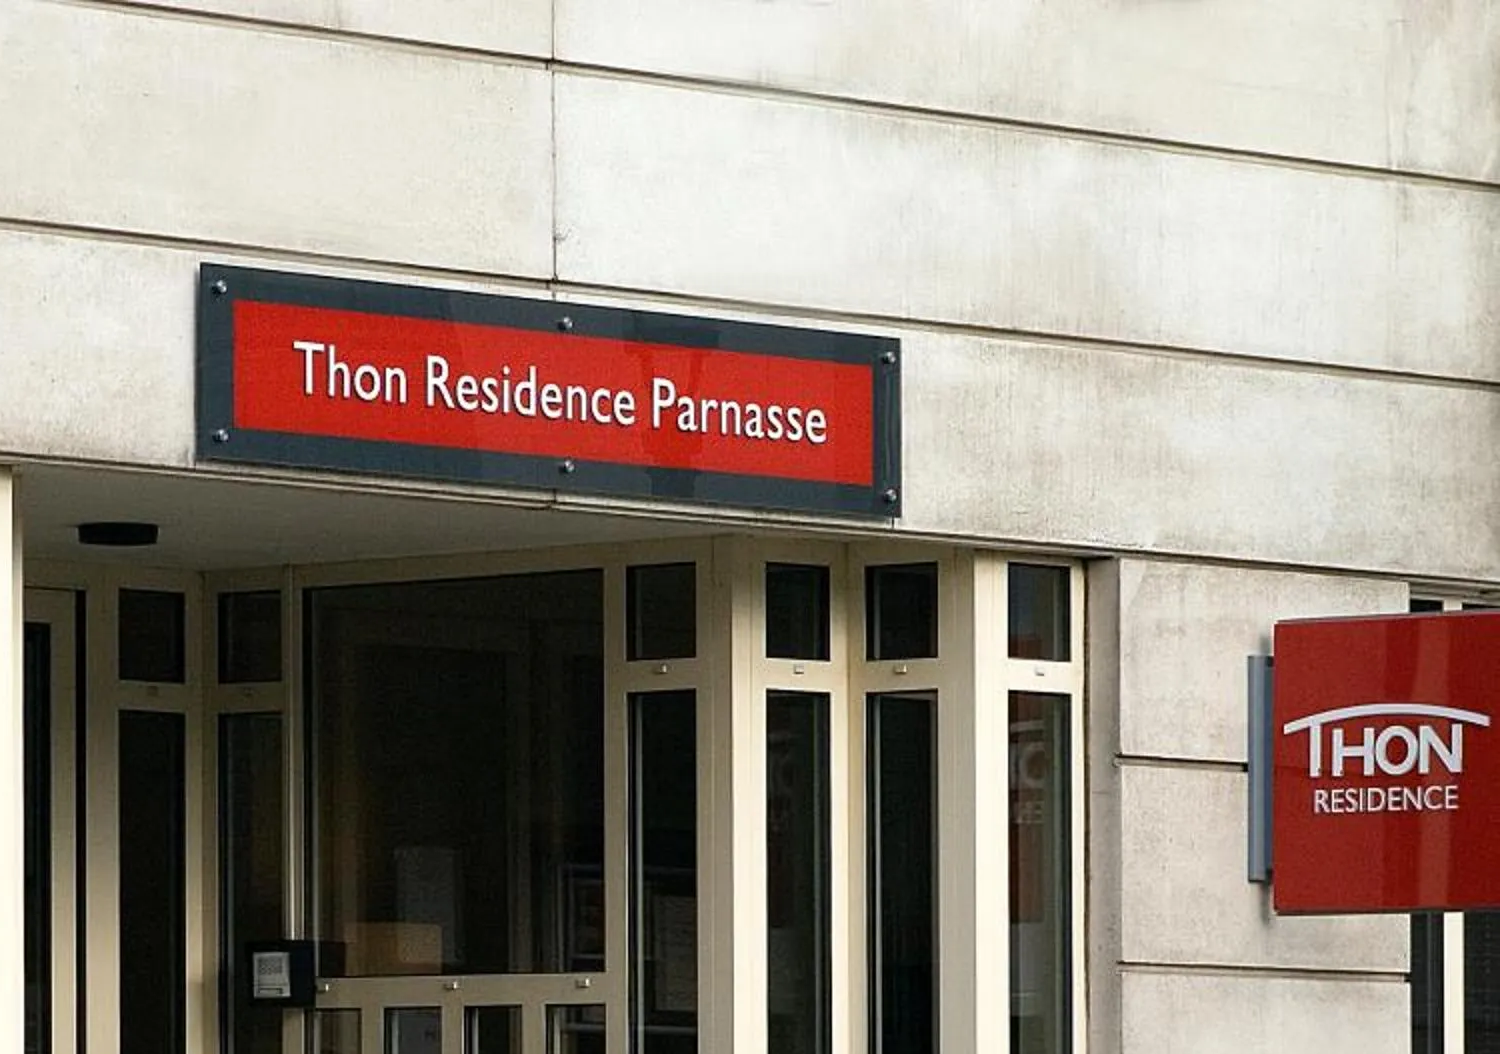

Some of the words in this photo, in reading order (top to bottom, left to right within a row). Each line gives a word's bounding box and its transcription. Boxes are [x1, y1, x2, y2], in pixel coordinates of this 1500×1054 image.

[293, 341, 407, 404] Thon
[427, 355, 636, 426] Residence
[653, 377, 827, 444] Parnasse
[1283, 703, 1491, 778] THON
[1314, 785, 1460, 814] RESIDENCE
